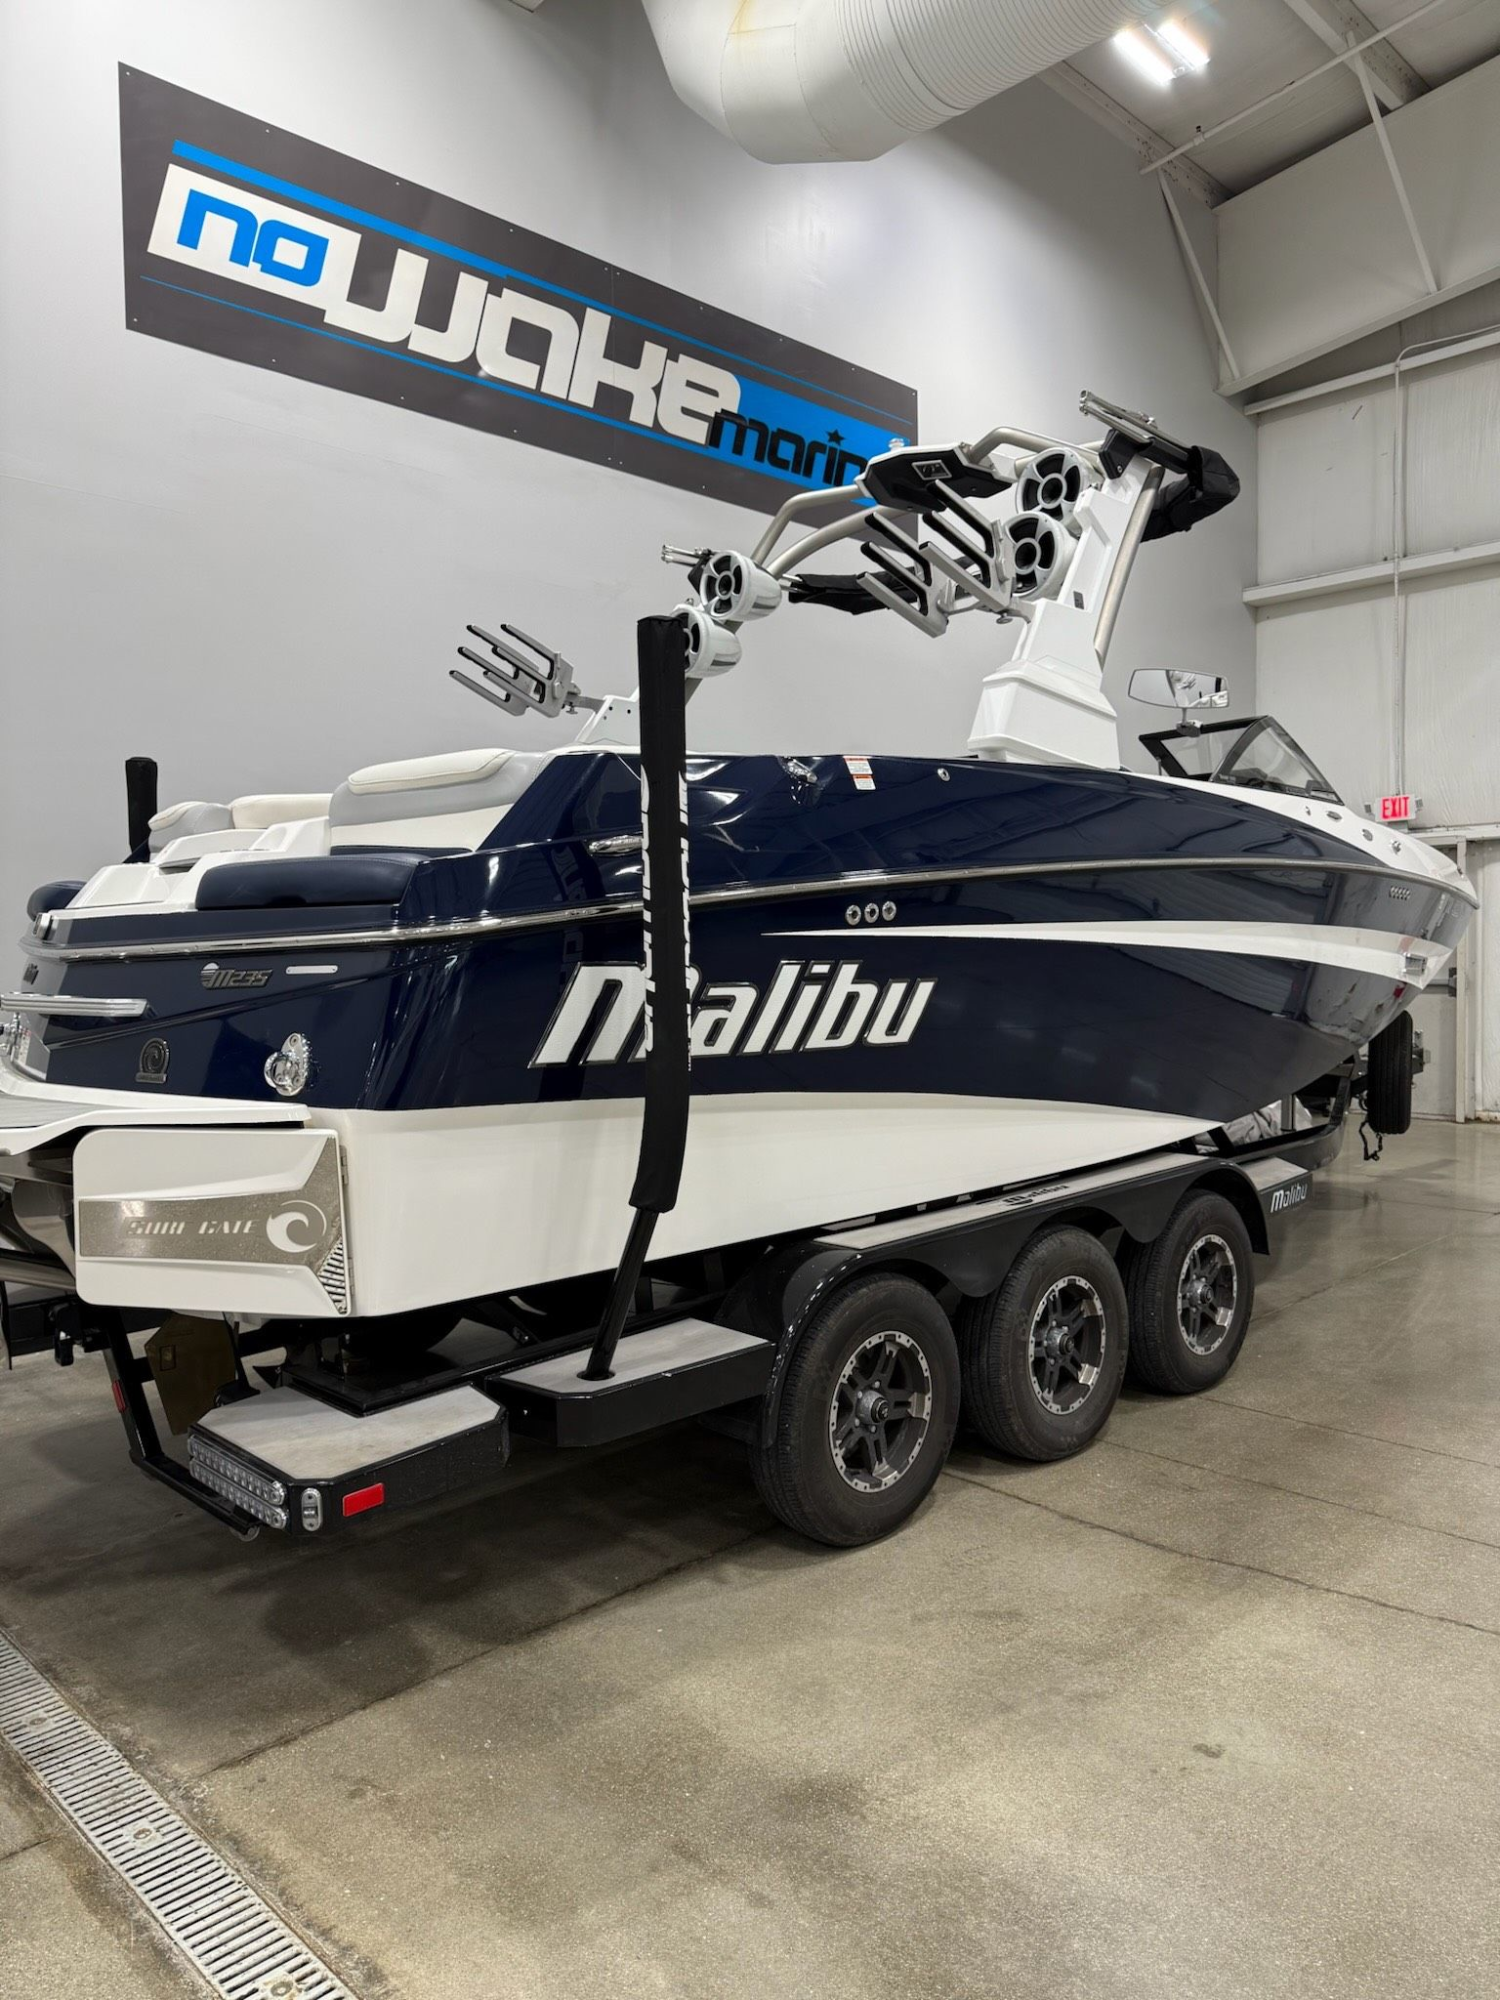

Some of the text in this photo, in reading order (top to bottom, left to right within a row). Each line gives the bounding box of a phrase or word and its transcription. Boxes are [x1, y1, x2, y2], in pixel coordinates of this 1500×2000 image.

[708, 408, 869, 488] marin
[1382, 796, 1410, 820] EXIT
[527, 959, 939, 1069] Malibu
[1270, 1183, 1308, 1214] Malibu
